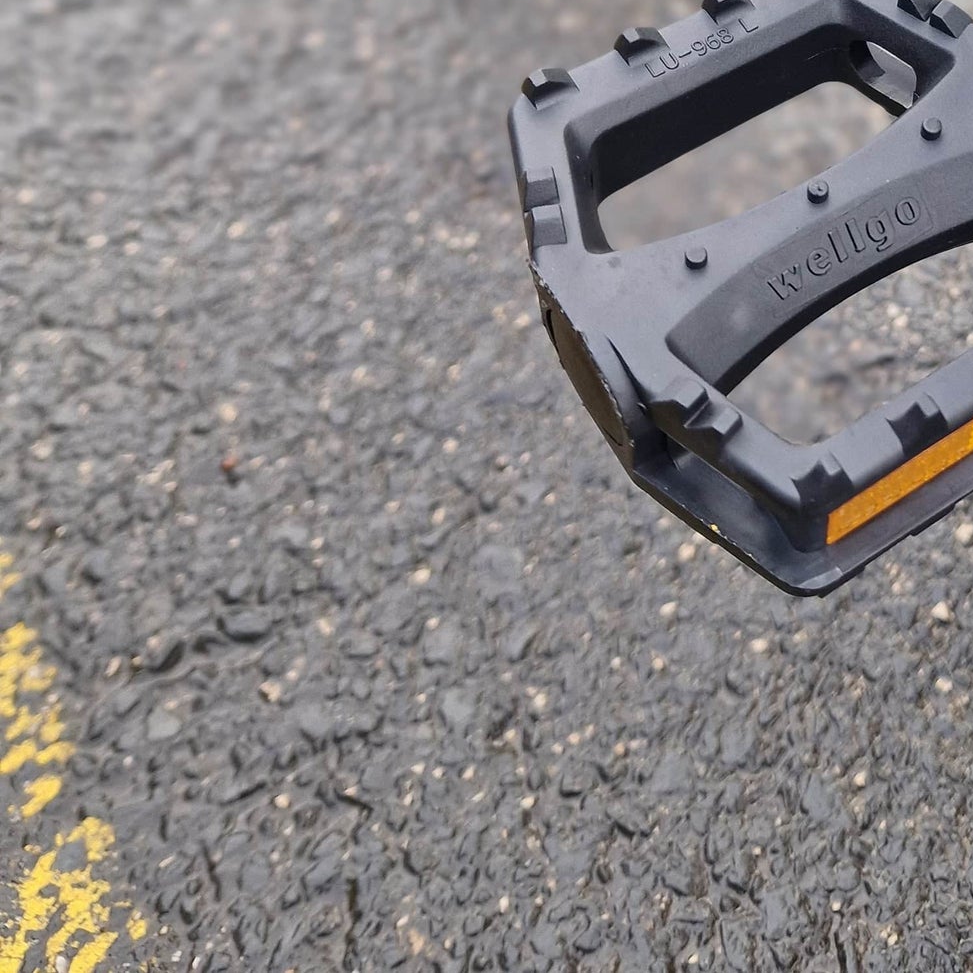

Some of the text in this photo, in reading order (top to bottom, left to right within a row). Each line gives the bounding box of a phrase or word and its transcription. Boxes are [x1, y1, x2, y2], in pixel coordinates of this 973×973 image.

[643, 16, 759, 79] LU-968 L
[765, 199, 923, 302] wellgo
